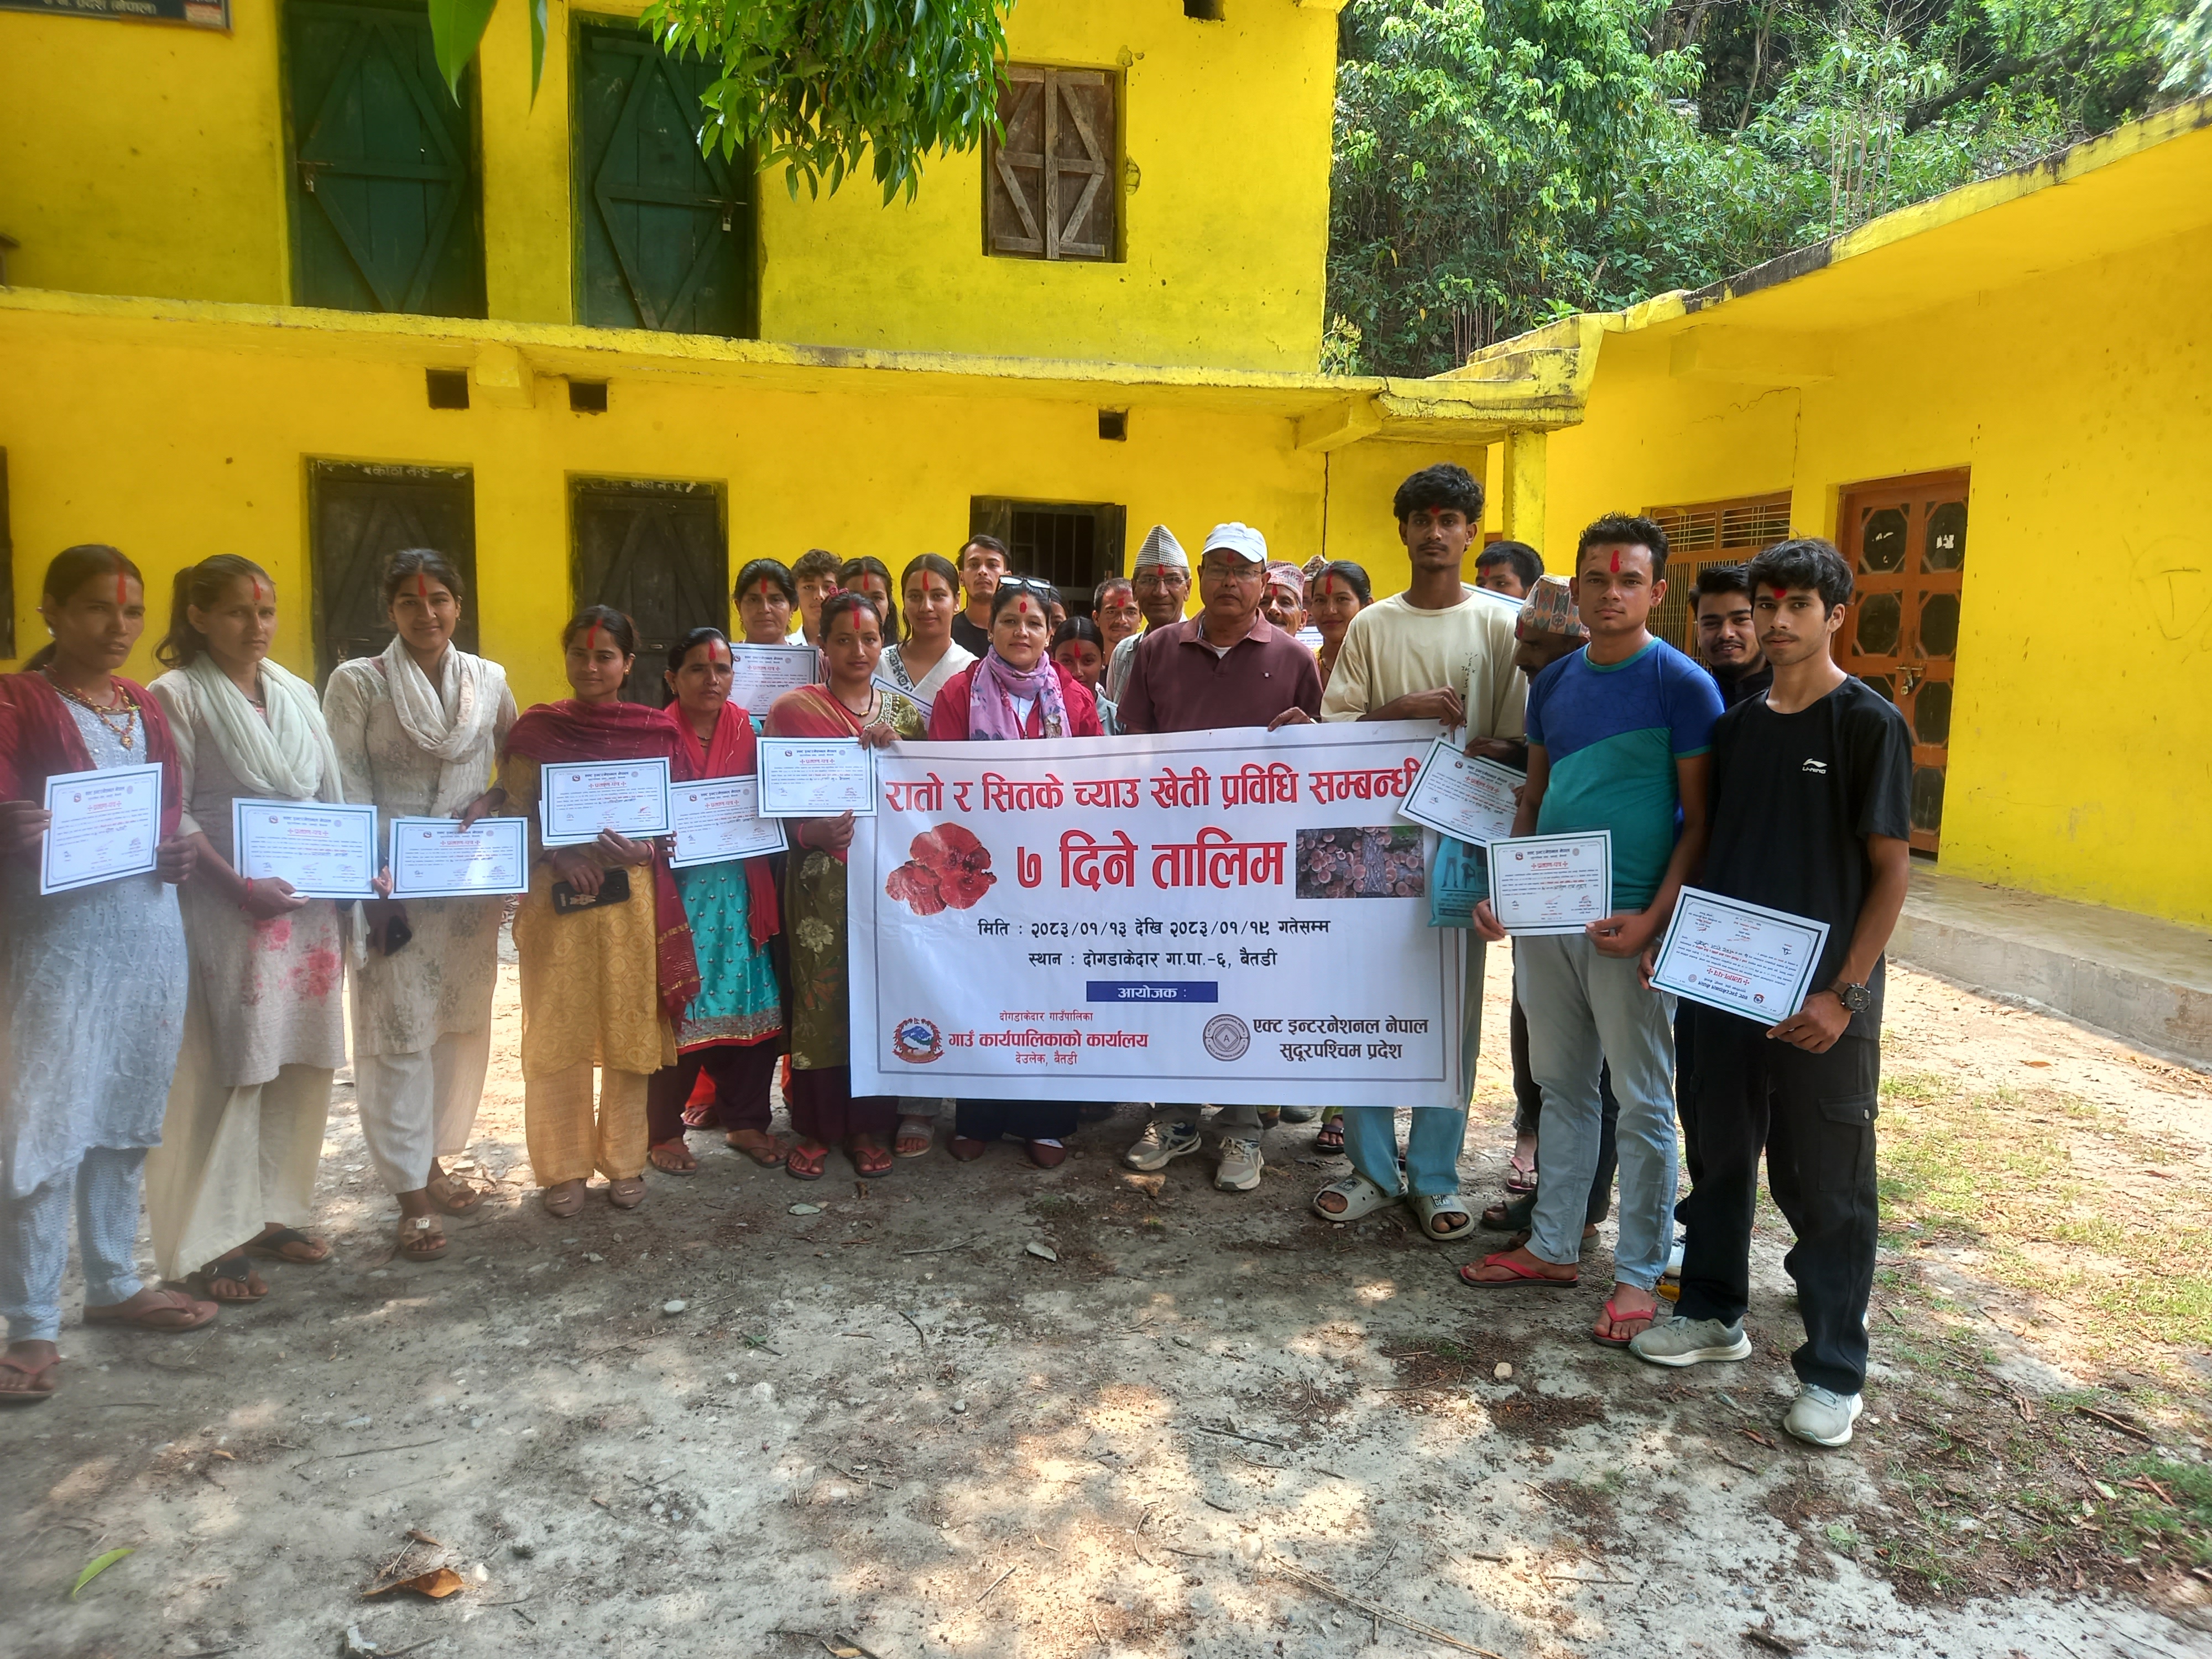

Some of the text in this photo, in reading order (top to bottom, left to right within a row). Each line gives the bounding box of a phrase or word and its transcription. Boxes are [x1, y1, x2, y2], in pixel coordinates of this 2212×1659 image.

[885, 772, 945, 813] रातो
[953, 782, 974, 812] र
[982, 772, 1065, 813] सितके
[1072, 779, 1141, 808] च्याउ
[1150, 766, 1212, 809] खेती
[1220, 762, 1299, 810] प्रविधि
[1308, 757, 1421, 805] सम्बन्धी
[1017, 827, 1287, 892] ७ दिने तालिम
[977, 918, 1011, 936] मिति
[1031, 921, 1127, 938] २०८३/०१/१३
[1134, 917, 1164, 937] देखि
[1170, 920, 1270, 938] २०८३/०१/१९
[1277, 917, 1331, 935] गतेसम्म
[1028, 953, 1063, 967] स्थान
[1083, 949, 1161, 968] दोगडाकेदार
[1165, 953, 1232, 969] गा.पा.-६,
[1239, 946, 1279, 967] बैतडी
[1118, 984, 1177, 999] आयोजक
[999, 1009, 1094, 1022] दोगडाकेदार गाउँपालिका
[1253, 1015, 1430, 1035] एक्ट इन्टरनेशनल नेपाल
[948, 1029, 1150, 1048] गाउँ कार्यपालिकाको कार्यालय
[1015, 1051, 1048, 1066] देउलेक,
[1279, 1039, 1403, 1062] सुदूरपश्चिम प्रदेश
